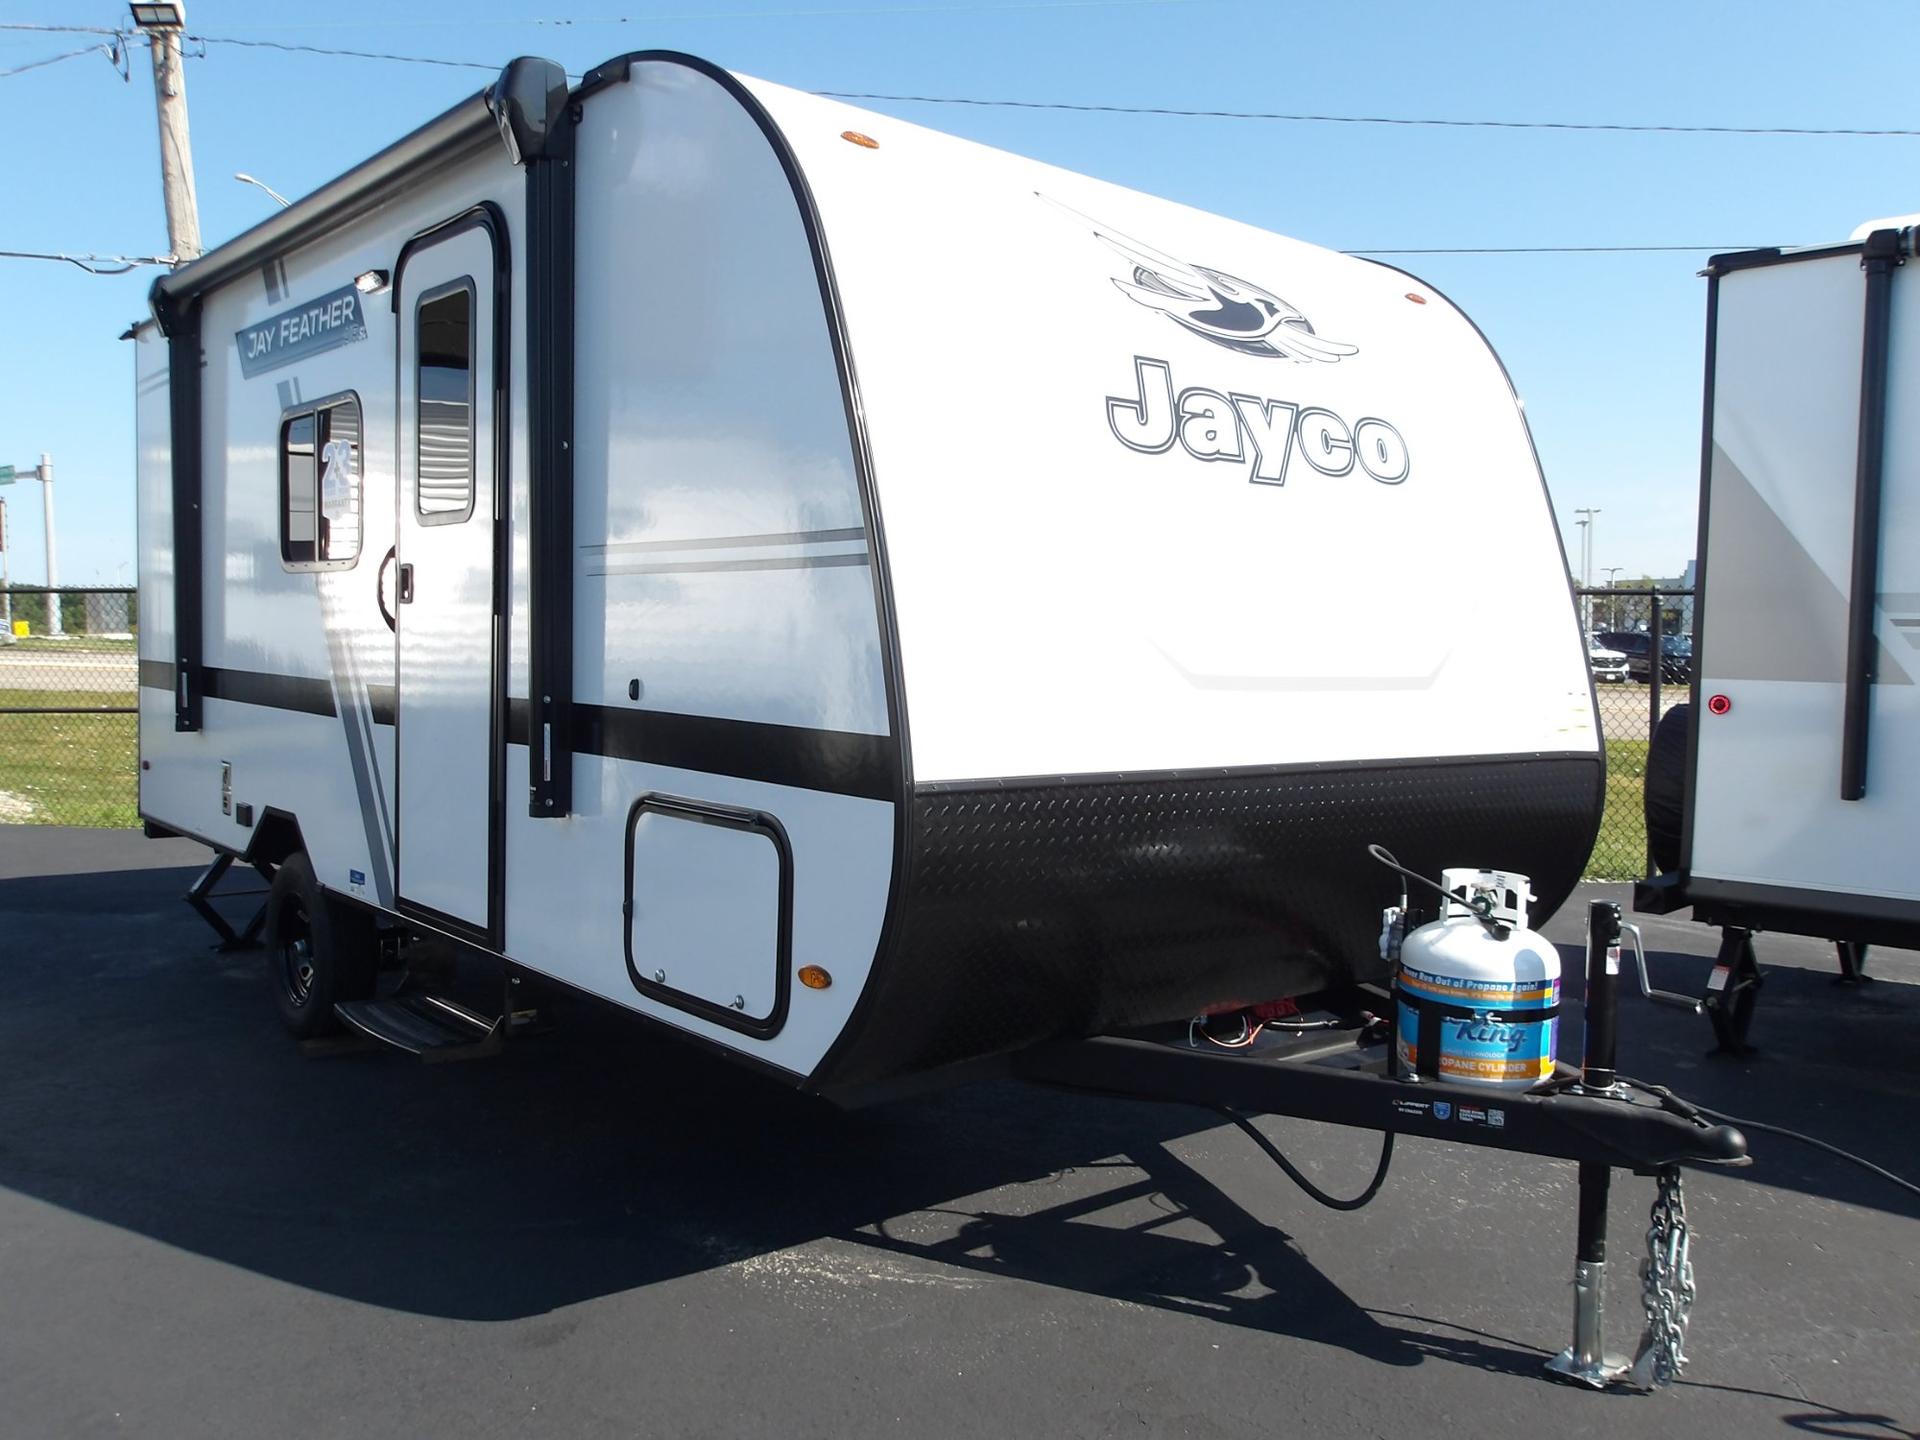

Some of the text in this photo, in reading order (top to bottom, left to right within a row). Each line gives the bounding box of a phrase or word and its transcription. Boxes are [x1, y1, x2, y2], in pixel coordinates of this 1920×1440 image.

[247, 326, 276, 359] JAY
[279, 295, 355, 347] FEATHER
[1105, 354, 1410, 487] Jayco
[1435, 975, 1451, 986] Out
[1453, 979, 1464, 988] of
[1466, 980, 1508, 992] Propane
[1508, 982, 1538, 993] Again!
[1456, 1018, 1526, 1052] King
[1439, 1057, 1527, 1073] OPANE CYLINDER
